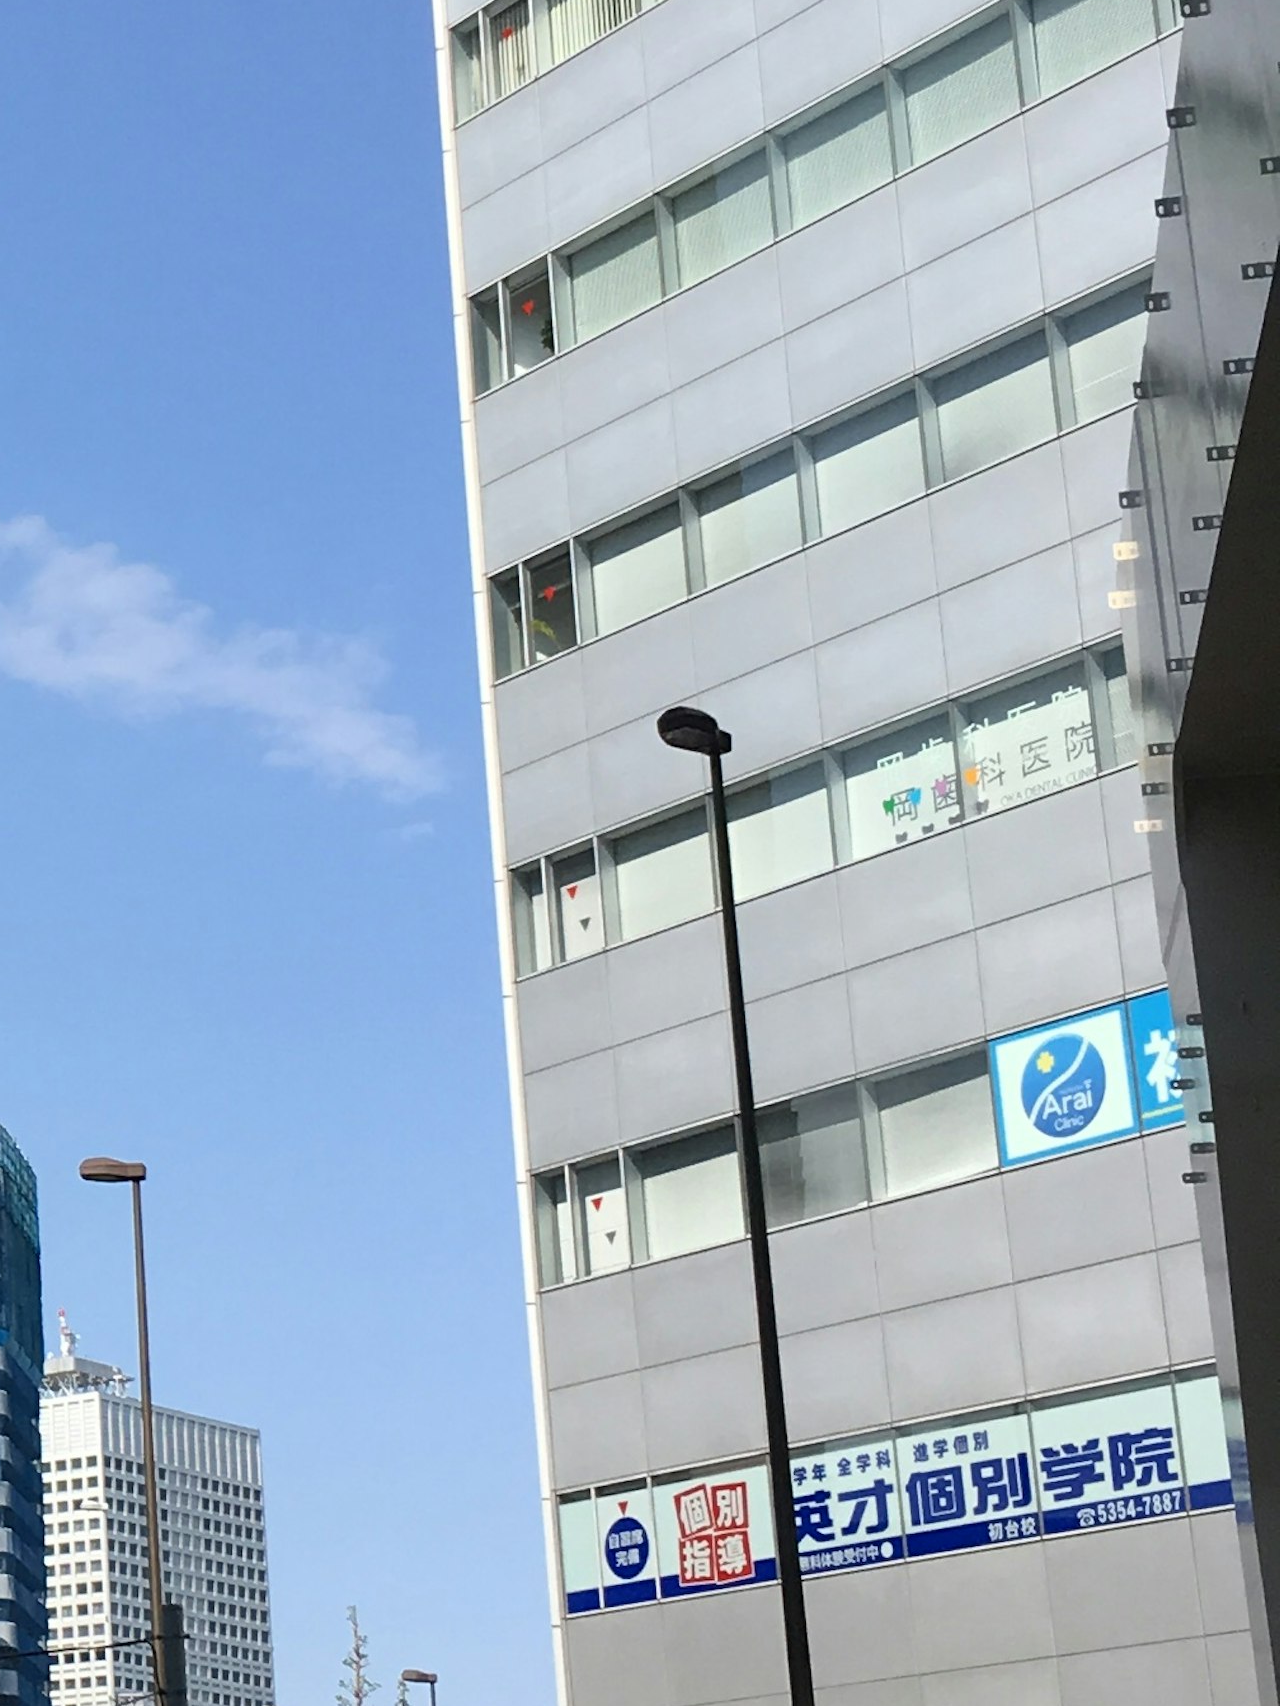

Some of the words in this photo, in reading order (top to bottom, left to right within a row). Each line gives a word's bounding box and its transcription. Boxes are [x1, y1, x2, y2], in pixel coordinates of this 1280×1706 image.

[1041, 1083, 1093, 1120] Arai
[1053, 1115, 1085, 1132] Clinic
[836, 1449, 891, 1477] 全学科
[913, 1429, 989, 1463] 進学個別
[679, 1485, 744, 1536] 個別
[987, 1516, 1037, 1542] 初台校
[682, 1535, 748, 1580] 指導
